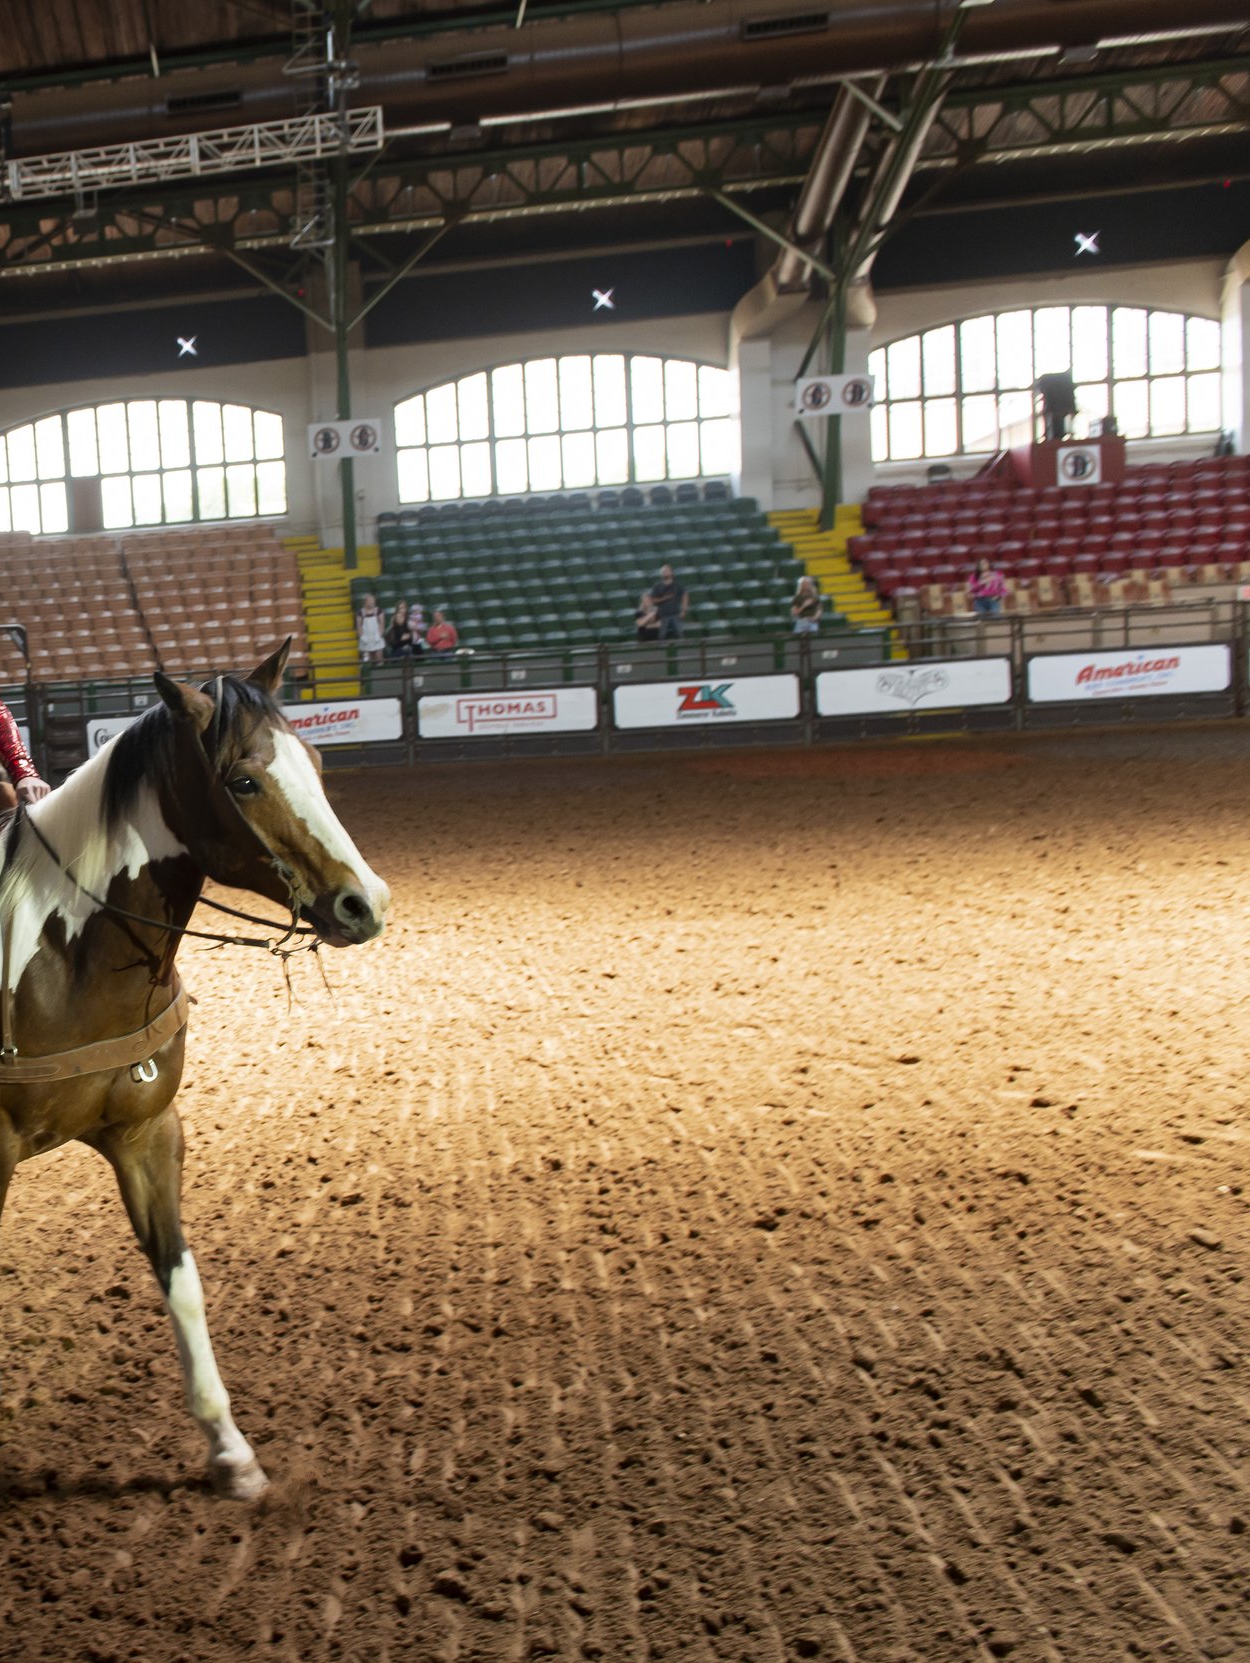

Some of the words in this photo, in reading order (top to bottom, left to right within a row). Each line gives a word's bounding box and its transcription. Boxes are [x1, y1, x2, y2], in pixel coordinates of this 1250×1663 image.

[1074, 655, 1181, 685] American
[677, 682, 735, 712] ZK
[290, 706, 359, 728] merican
[464, 700, 547, 733] THOMAS
